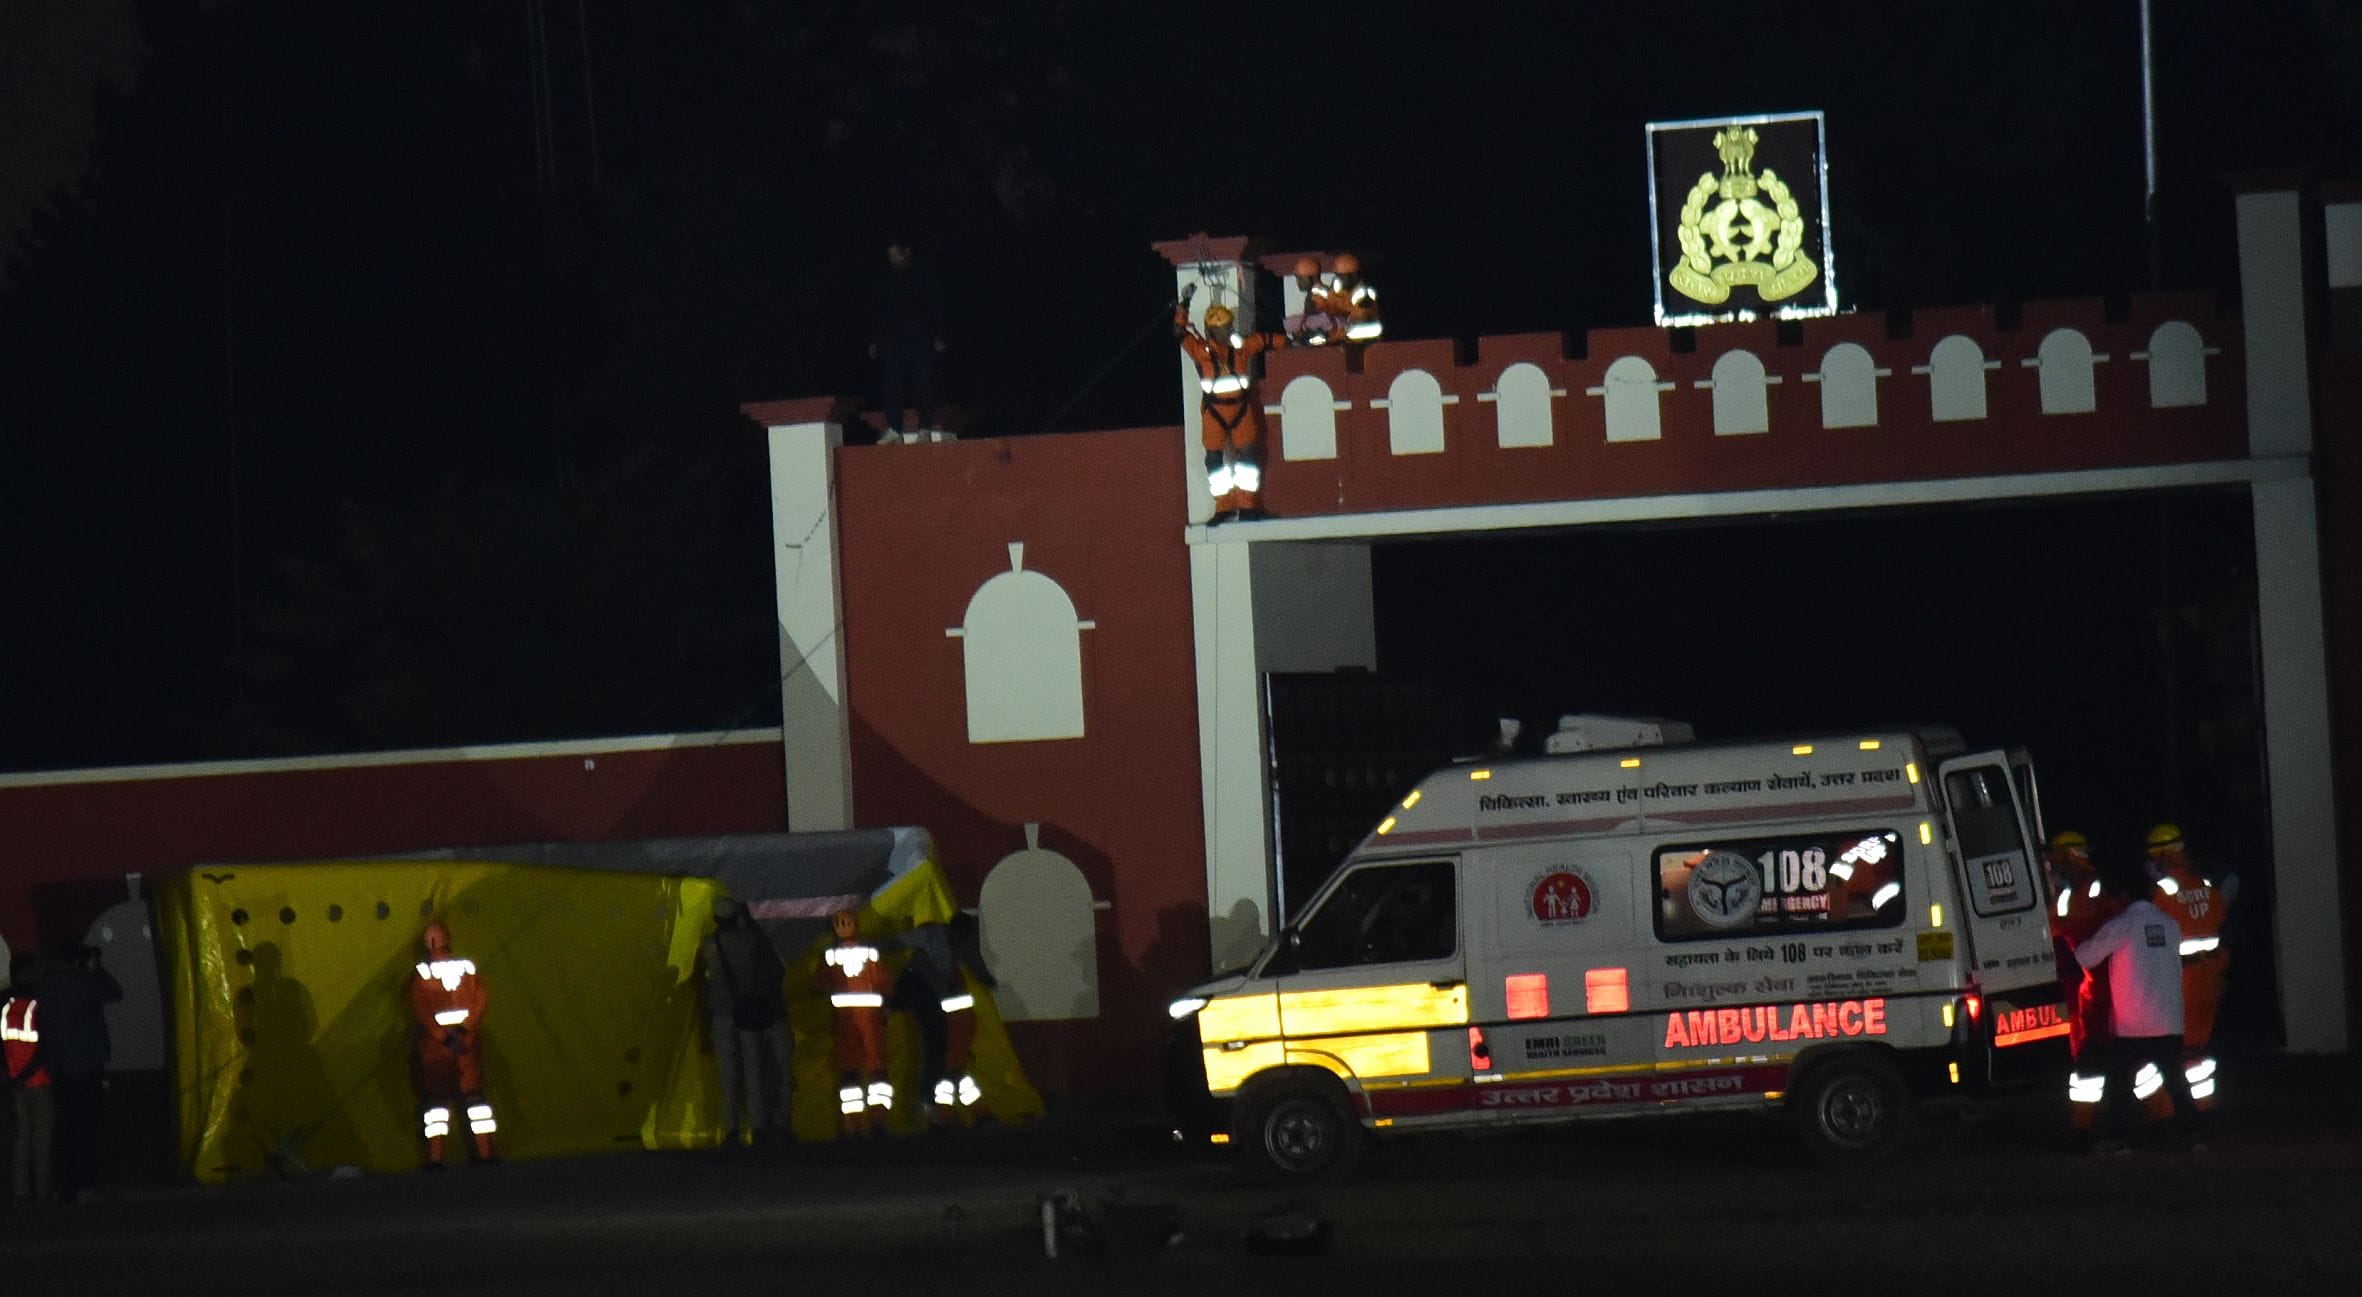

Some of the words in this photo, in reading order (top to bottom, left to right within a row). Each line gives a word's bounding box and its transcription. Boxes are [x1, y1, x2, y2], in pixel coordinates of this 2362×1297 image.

[1644, 782, 1698, 799] परिवार
[1704, 780, 1761, 795] कल्याण
[1820, 772, 1855, 787] उत्तर
[1757, 847, 1827, 894] 108
[1986, 861, 2013, 888] 108
[1666, 953, 1719, 968] सहायता
[1724, 948, 1740, 962] के
[1781, 942, 1806, 963] 108
[1812, 946, 1833, 958] पर
[1877, 938, 1903, 954] करें
[1755, 976, 1795, 992] सेवा
[1665, 998, 1887, 1048] AMBULANCE
[1997, 1004, 2062, 1034] AMBUL
[1481, 1087, 1561, 1105] उत्तर
[1567, 1080, 1641, 1102] प्रदेश
[1652, 1075, 1743, 1097] शासन
